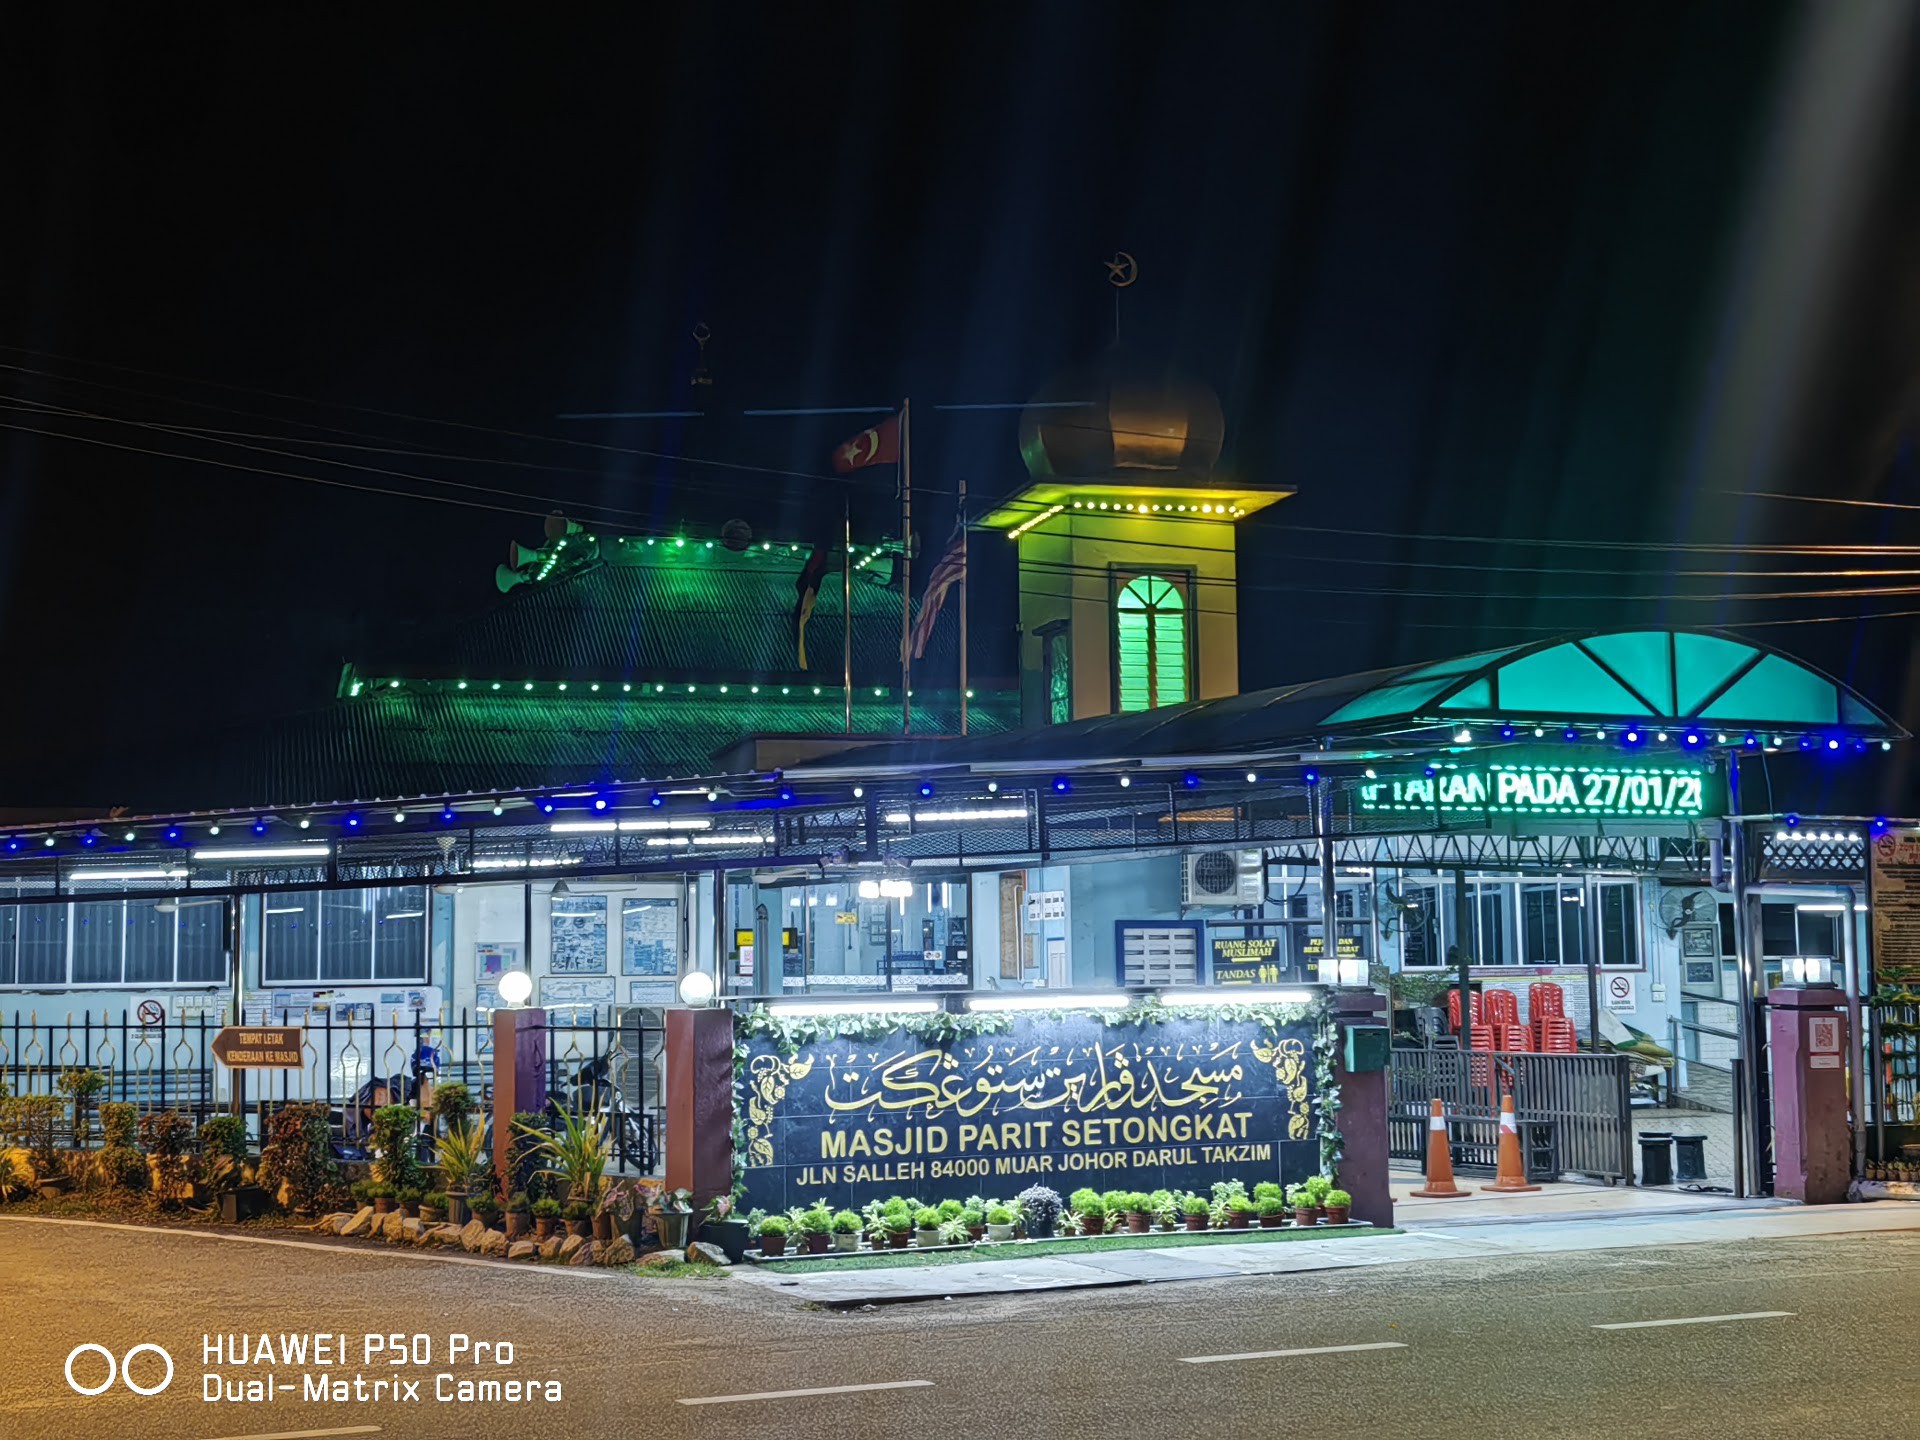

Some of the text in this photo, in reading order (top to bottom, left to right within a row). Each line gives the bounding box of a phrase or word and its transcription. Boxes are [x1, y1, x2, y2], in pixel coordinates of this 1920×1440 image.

[1498, 773, 1580, 805] PADA
[1214, 939, 1277, 950] RUANG SOLAT
[1222, 947, 1272, 958] MUSLIMAH
[1215, 969, 1256, 979] TANDAS
[239, 1033, 284, 1044] TEMPAT LETAK
[226, 1051, 298, 1062] KENDERAAN KE MASJID
[1132, 1046, 1243, 1110] مسجد
[821, 1112, 1253, 1159] MASJID PARIT SETONGKAT
[796, 1144, 1271, 1186] JLN SALLEH 84000 MUAR JOHOR DARUL TAKZIM
